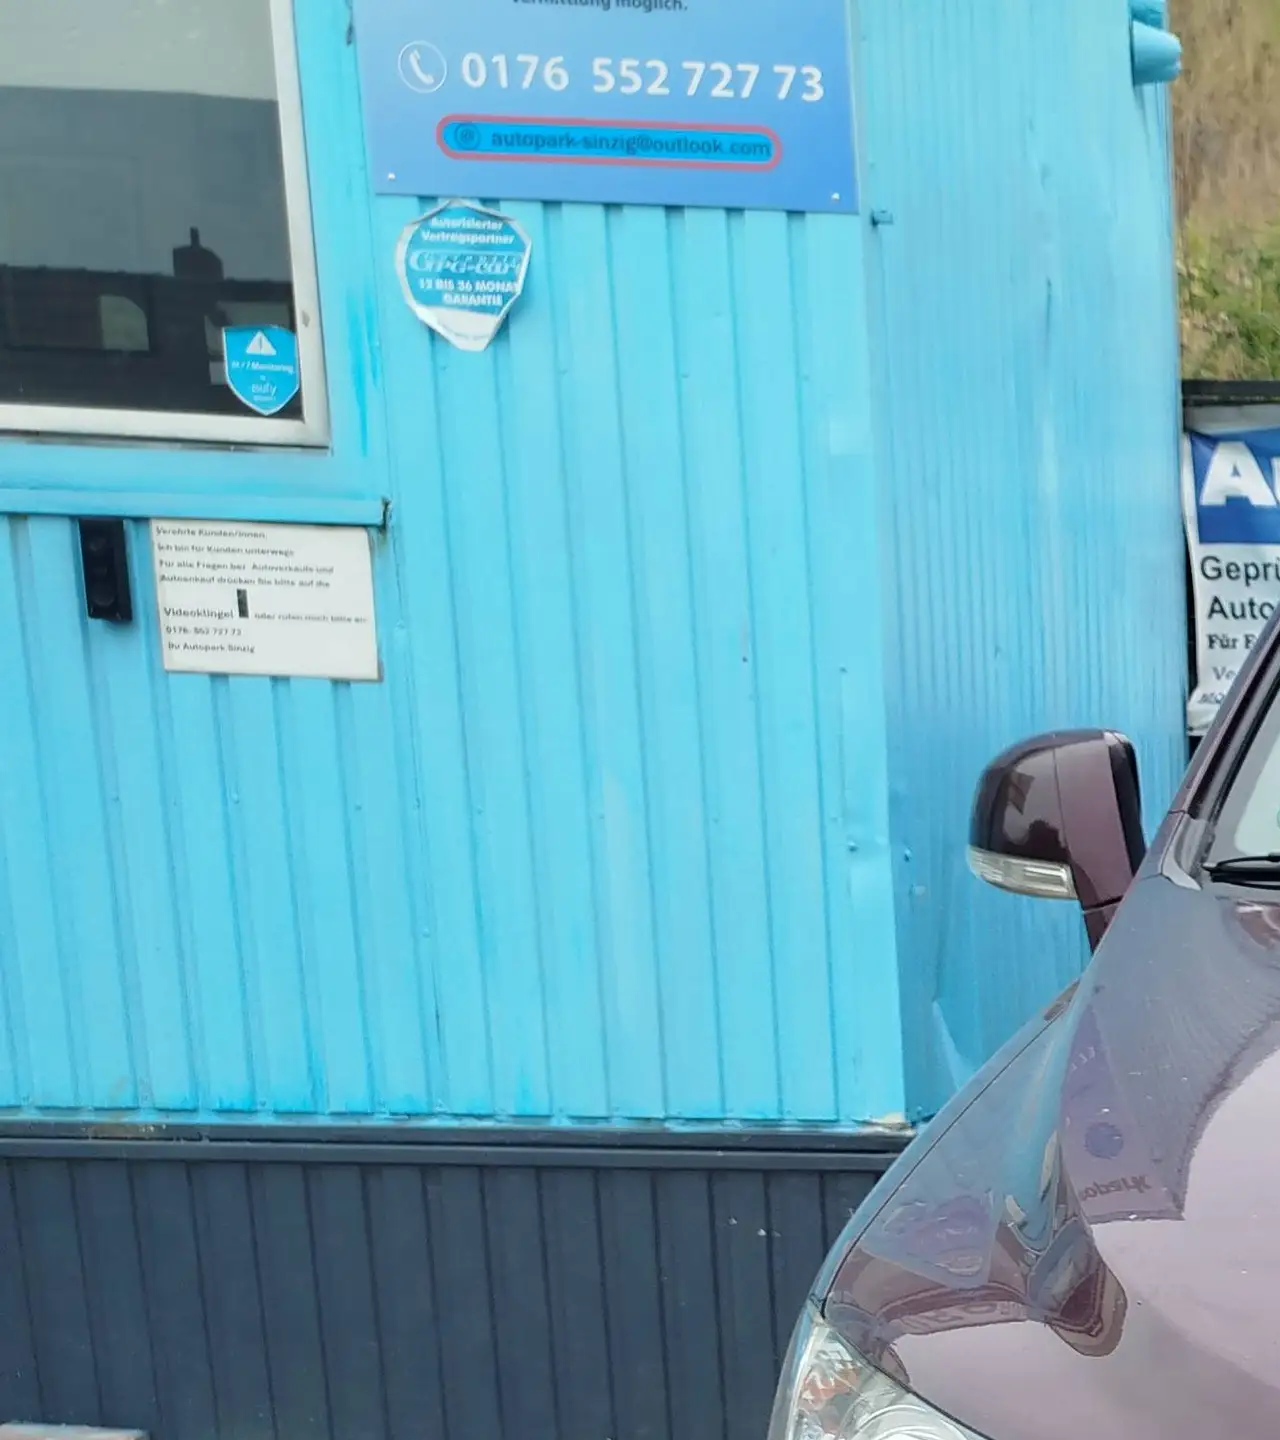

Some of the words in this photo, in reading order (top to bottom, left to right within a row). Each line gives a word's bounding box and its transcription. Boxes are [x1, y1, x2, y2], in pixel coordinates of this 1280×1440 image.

[461, 52, 570, 91] 0176
[591, 57, 671, 95] 552
[681, 60, 761, 99] 727
[772, 64, 825, 102] 73
